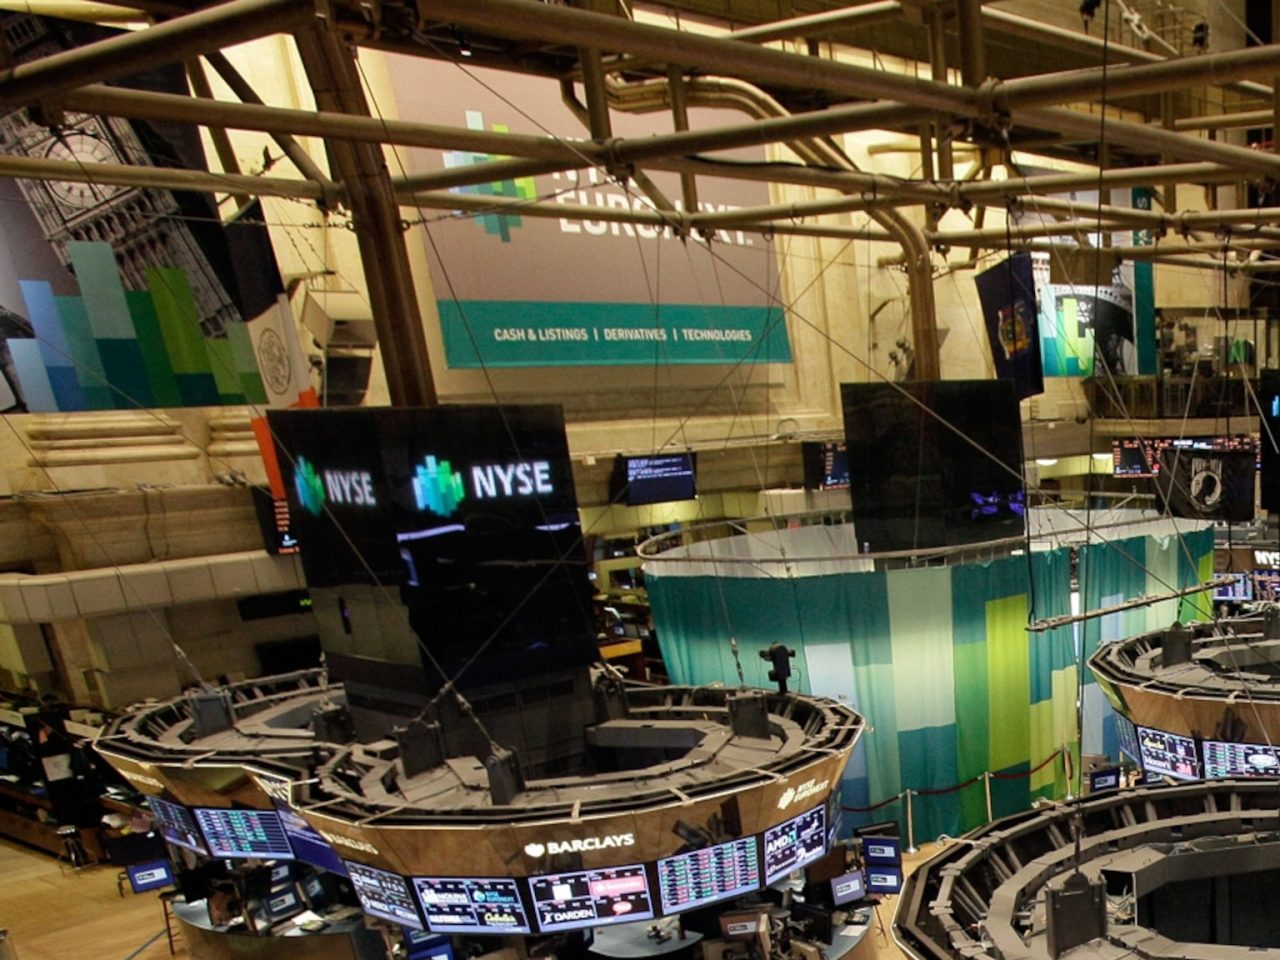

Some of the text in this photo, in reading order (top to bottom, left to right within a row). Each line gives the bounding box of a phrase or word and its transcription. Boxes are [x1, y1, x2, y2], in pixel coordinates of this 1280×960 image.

[494, 328, 752, 342] CASH & LISTINGS DERIVATIVES TECHNOLOGIES
[324, 469, 376, 506] NYSE
[470, 461, 553, 498] NYSE
[547, 833, 635, 855] BARCLAYS
[554, 909, 594, 922] DARDEN
